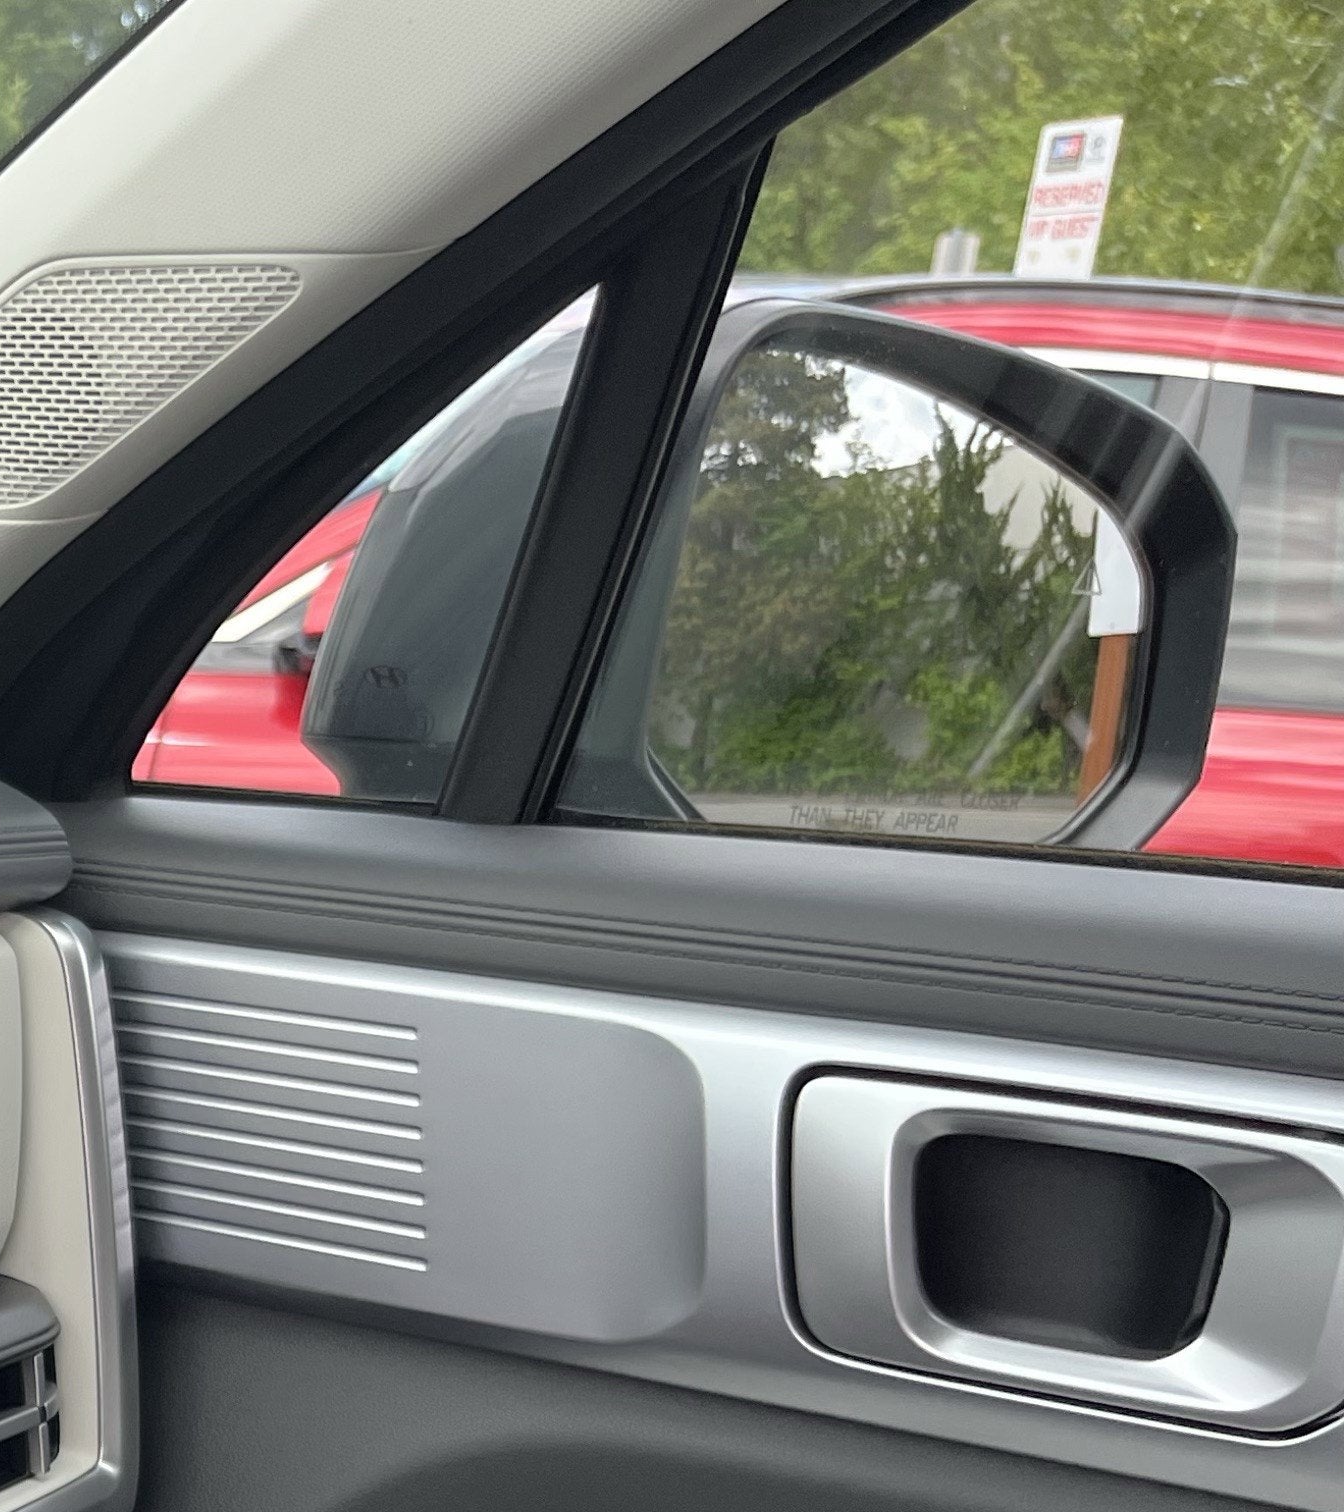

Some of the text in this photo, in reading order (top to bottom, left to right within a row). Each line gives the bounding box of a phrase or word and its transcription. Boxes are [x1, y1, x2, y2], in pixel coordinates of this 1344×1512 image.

[789, 804, 960, 833] THAN THEY APPEAR
